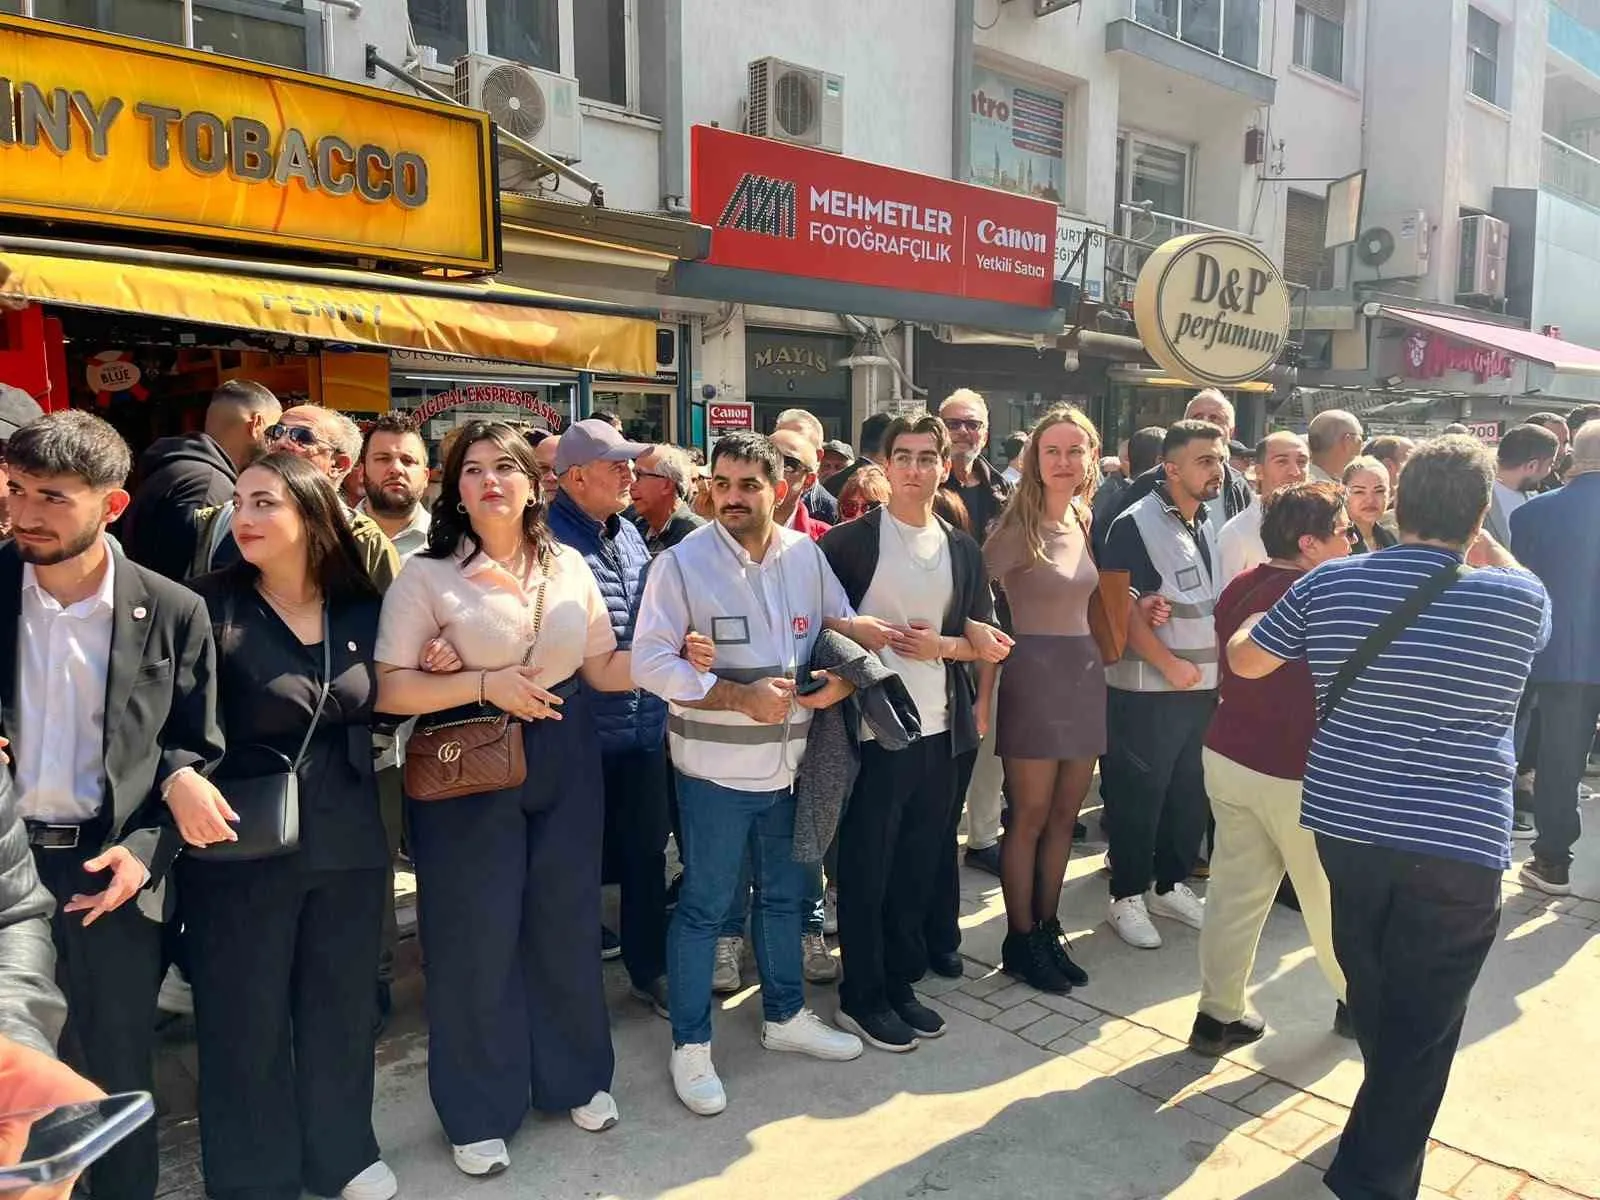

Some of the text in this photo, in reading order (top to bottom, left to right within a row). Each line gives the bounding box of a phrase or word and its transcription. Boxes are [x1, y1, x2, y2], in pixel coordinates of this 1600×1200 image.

[134, 101, 430, 210] TOBACCO
[809, 186, 953, 235] MEHMETLER
[808, 221, 952, 264] FOTOĞRAFÇILIK
[976, 219, 1047, 254] Canon
[975, 253, 1046, 279] Yetkili Satıcı
[1174, 311, 1279, 353] perfumum
[754, 346, 829, 372] MAYIS
[101, 368, 132, 384] BLUE
[466, 384, 522, 407] EKSPRES
[710, 406, 748, 418] Canon
